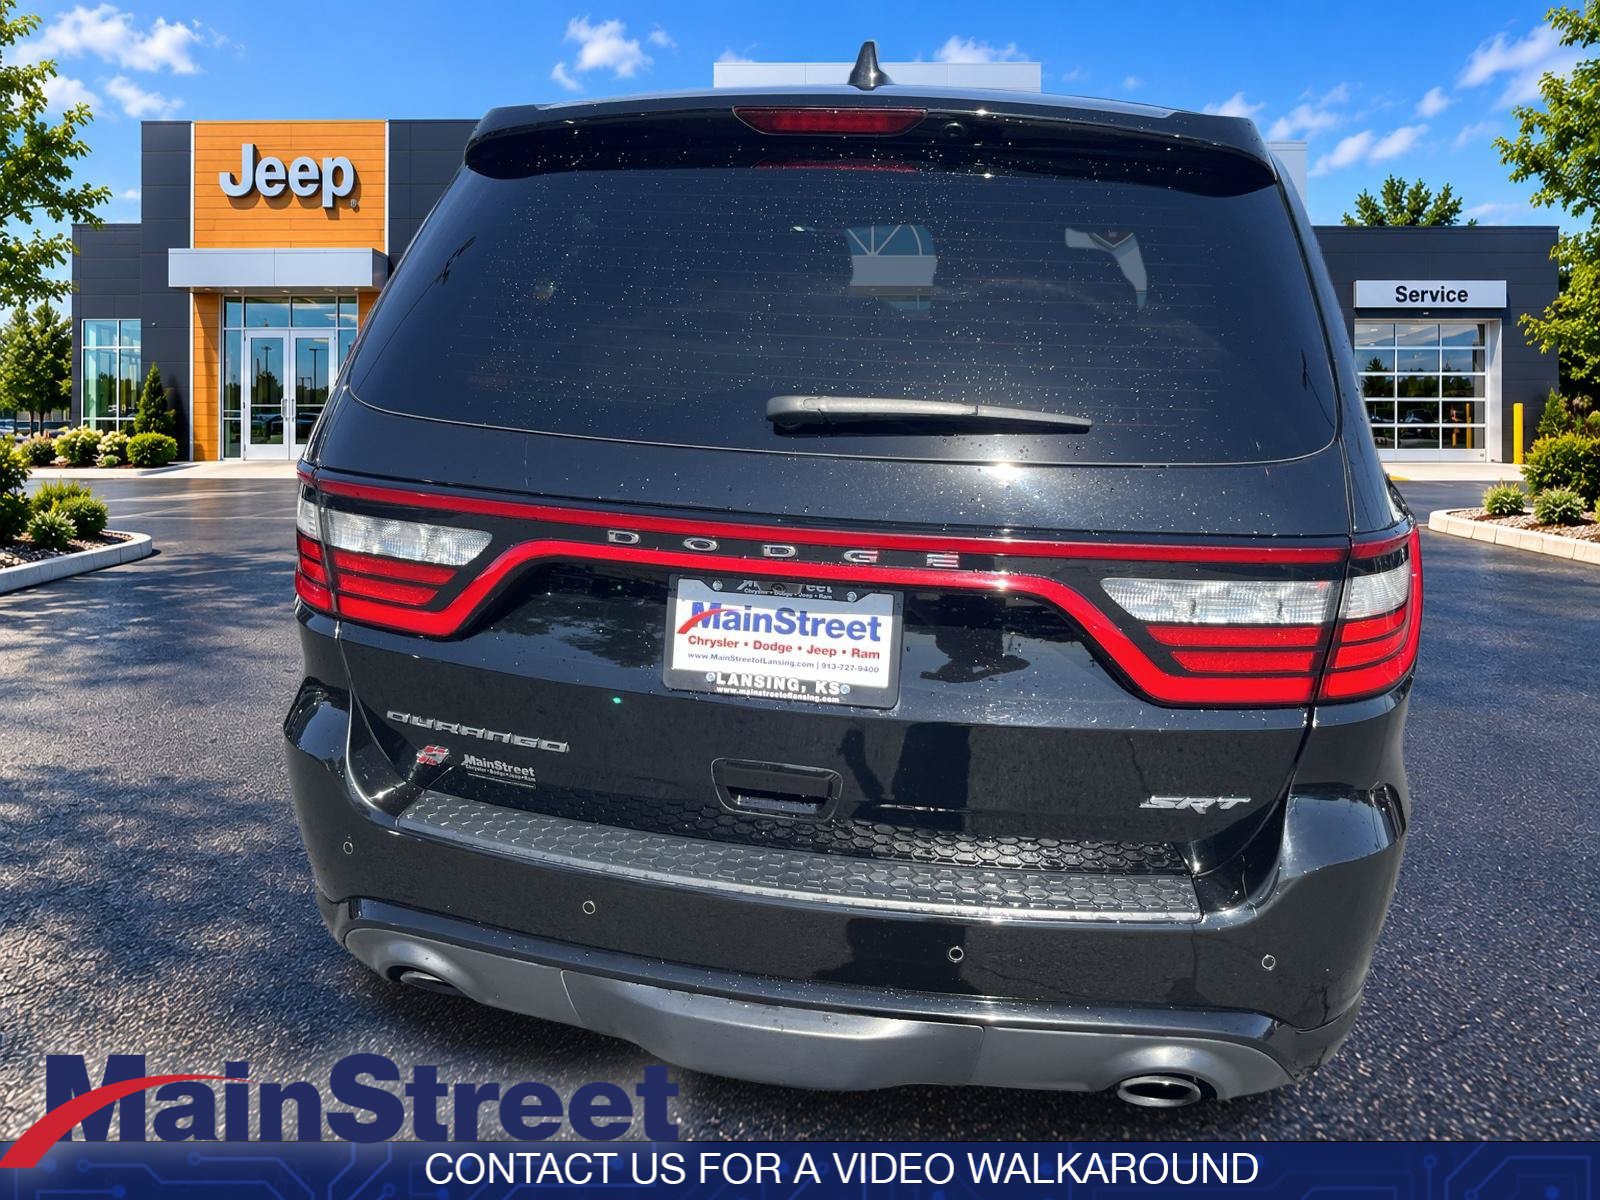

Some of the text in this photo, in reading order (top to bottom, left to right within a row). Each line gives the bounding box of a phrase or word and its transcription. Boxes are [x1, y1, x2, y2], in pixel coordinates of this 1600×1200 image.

[219, 143, 354, 208] Jeep
[1395, 285, 1469, 303] Service
[607, 529, 960, 568] DODGE
[690, 601, 882, 642] MainStreet
[687, 635, 881, 660] Chrysler Dodge Jeep Ram
[687, 651, 880, 673] www.MainStreetofLansing.com 913-727-9400
[715, 672, 841, 695] LANSING, KS
[386, 710, 571, 753] DURANGO
[463, 753, 536, 777] MainStreet
[1139, 796, 1251, 814] SRT
